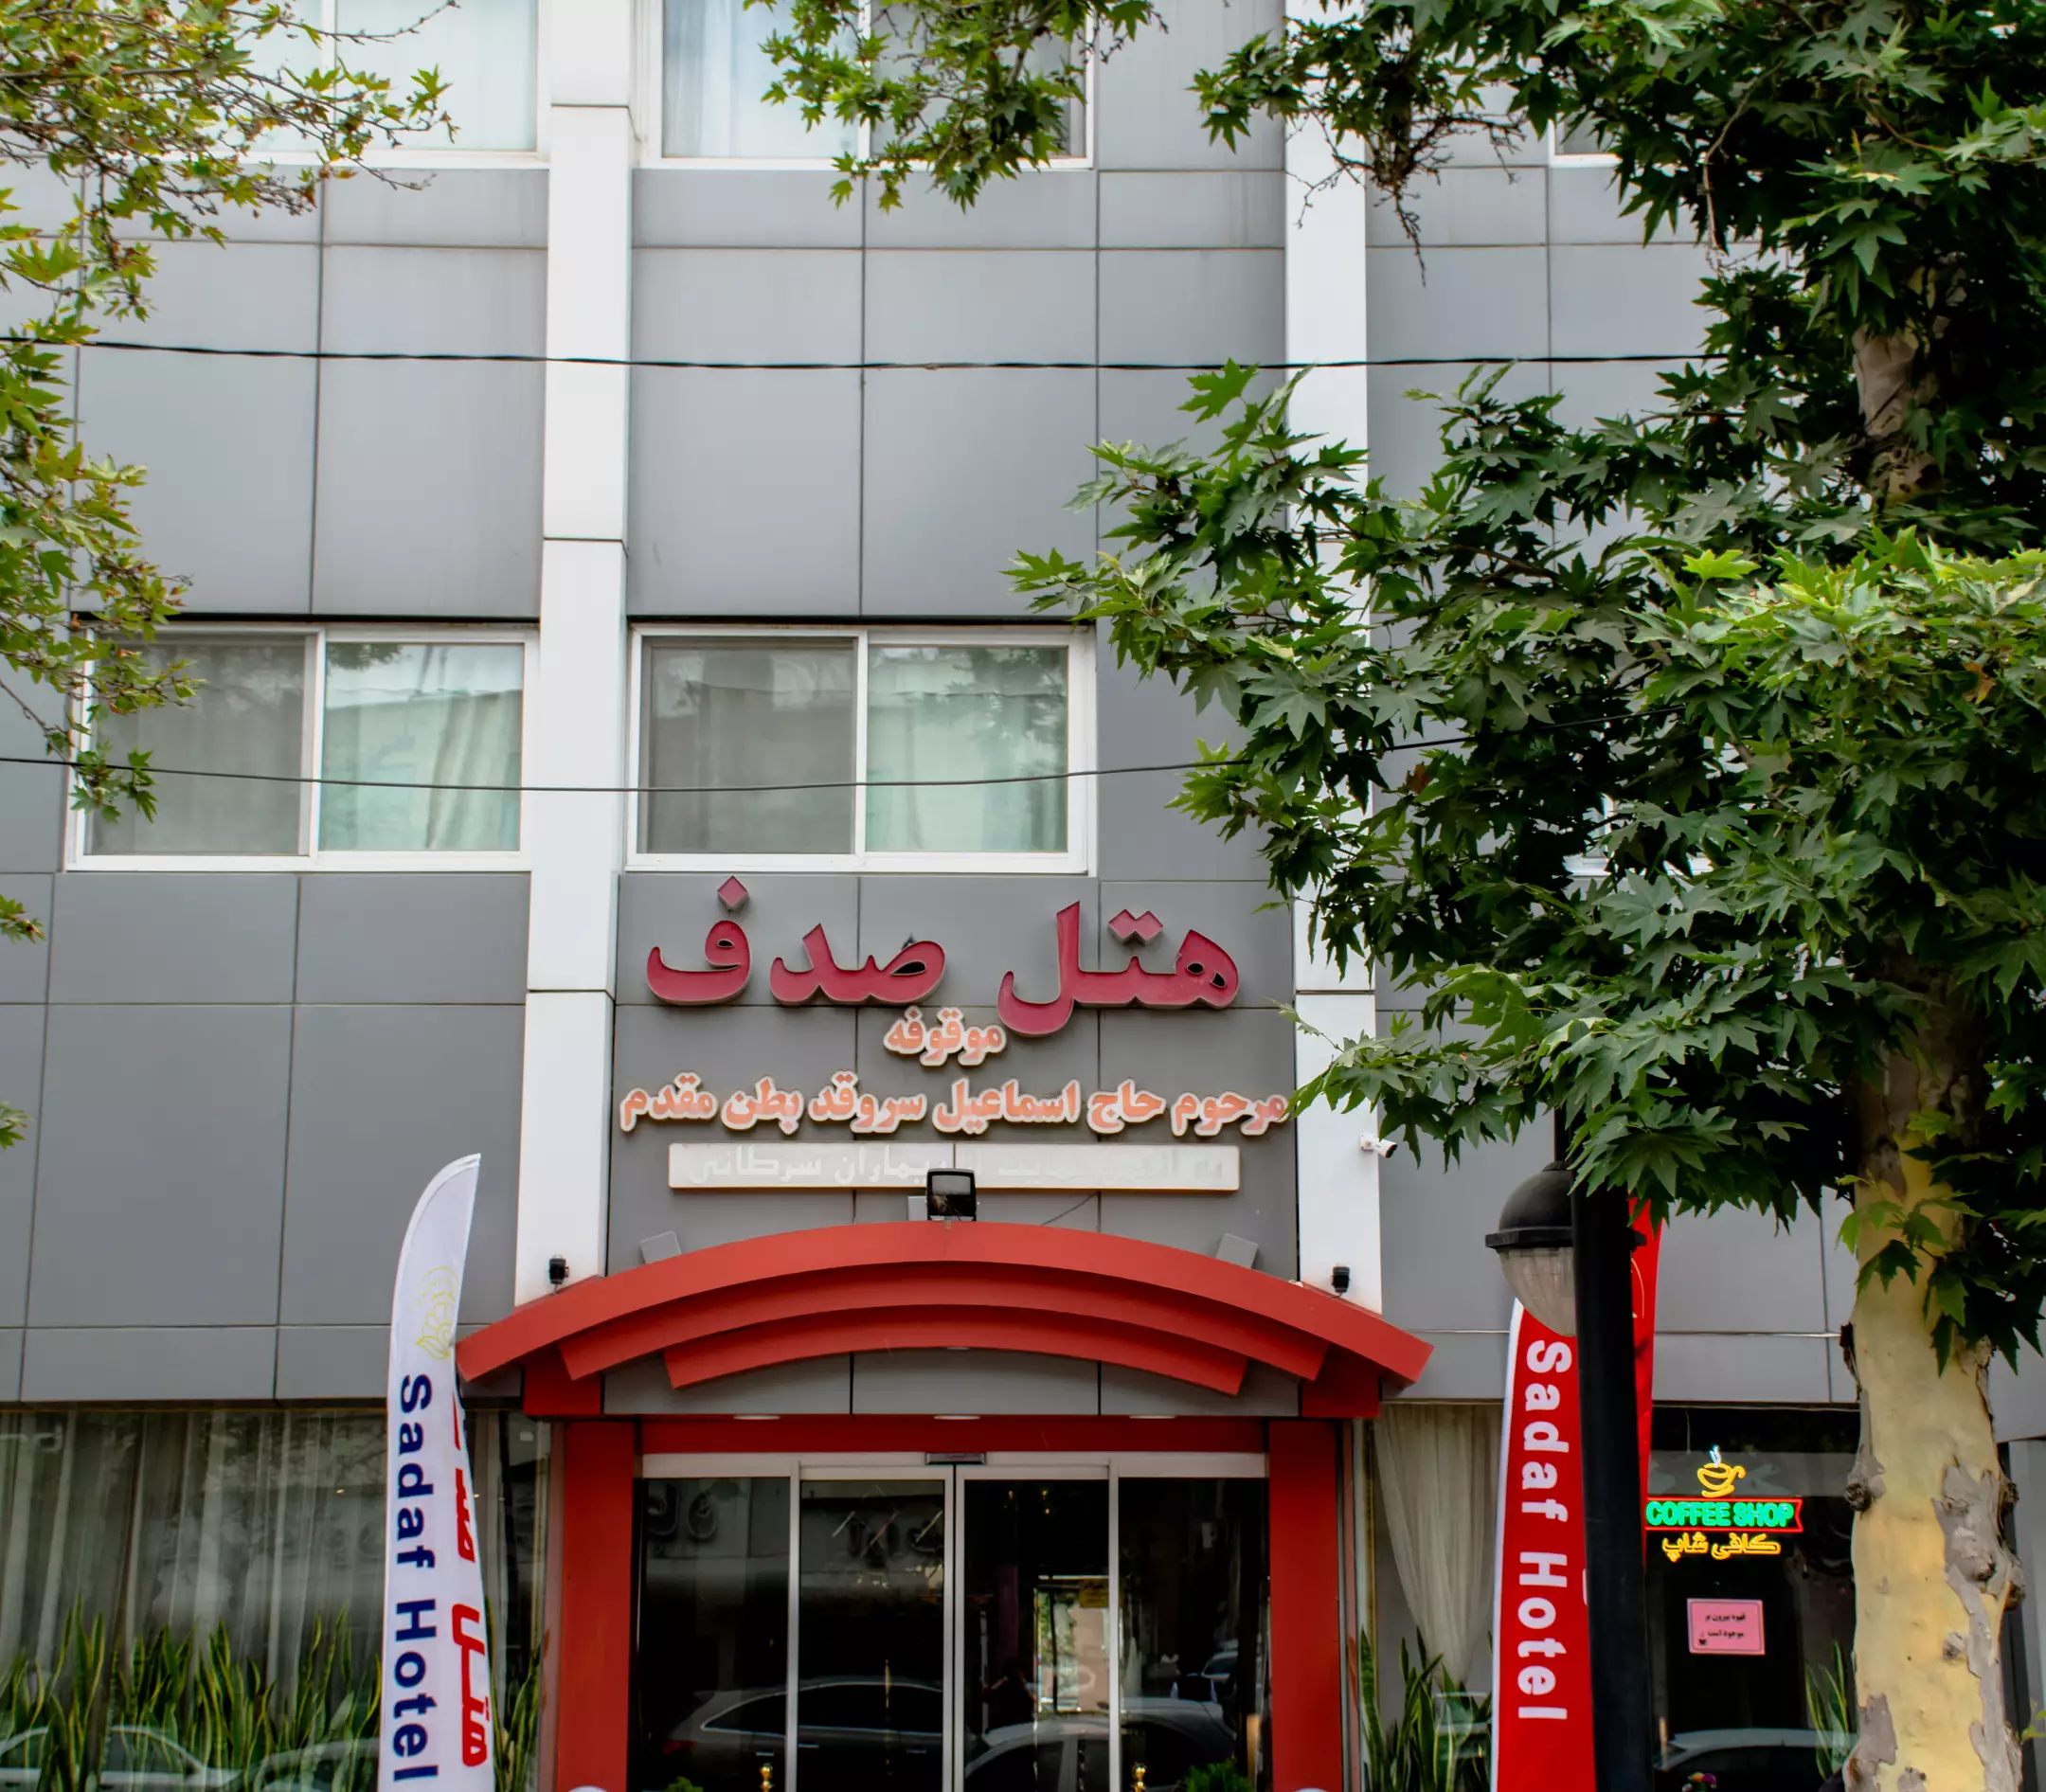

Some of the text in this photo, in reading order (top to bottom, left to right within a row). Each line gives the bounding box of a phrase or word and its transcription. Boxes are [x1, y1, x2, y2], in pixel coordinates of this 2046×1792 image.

[647, 876, 1240, 1036] هتل صدف
[884, 1005, 1006, 1066] موقوفه
[619, 1071, 718, 1133] مقدم
[721, 1076, 804, 1136] بطن
[932, 1078, 1080, 1135] اسماعیل
[1087, 1079, 1167, 1135] حاج
[1171, 1092, 1290, 1137] مرحوم
[1517, 1339, 1573, 1720] Sadaf Hotel
[1645, 1500, 1795, 1528] COFFEE SHOP
[1661, 1532, 1710, 1563] شاپ
[392, 1373, 440, 1783] Sadaf Hotel
